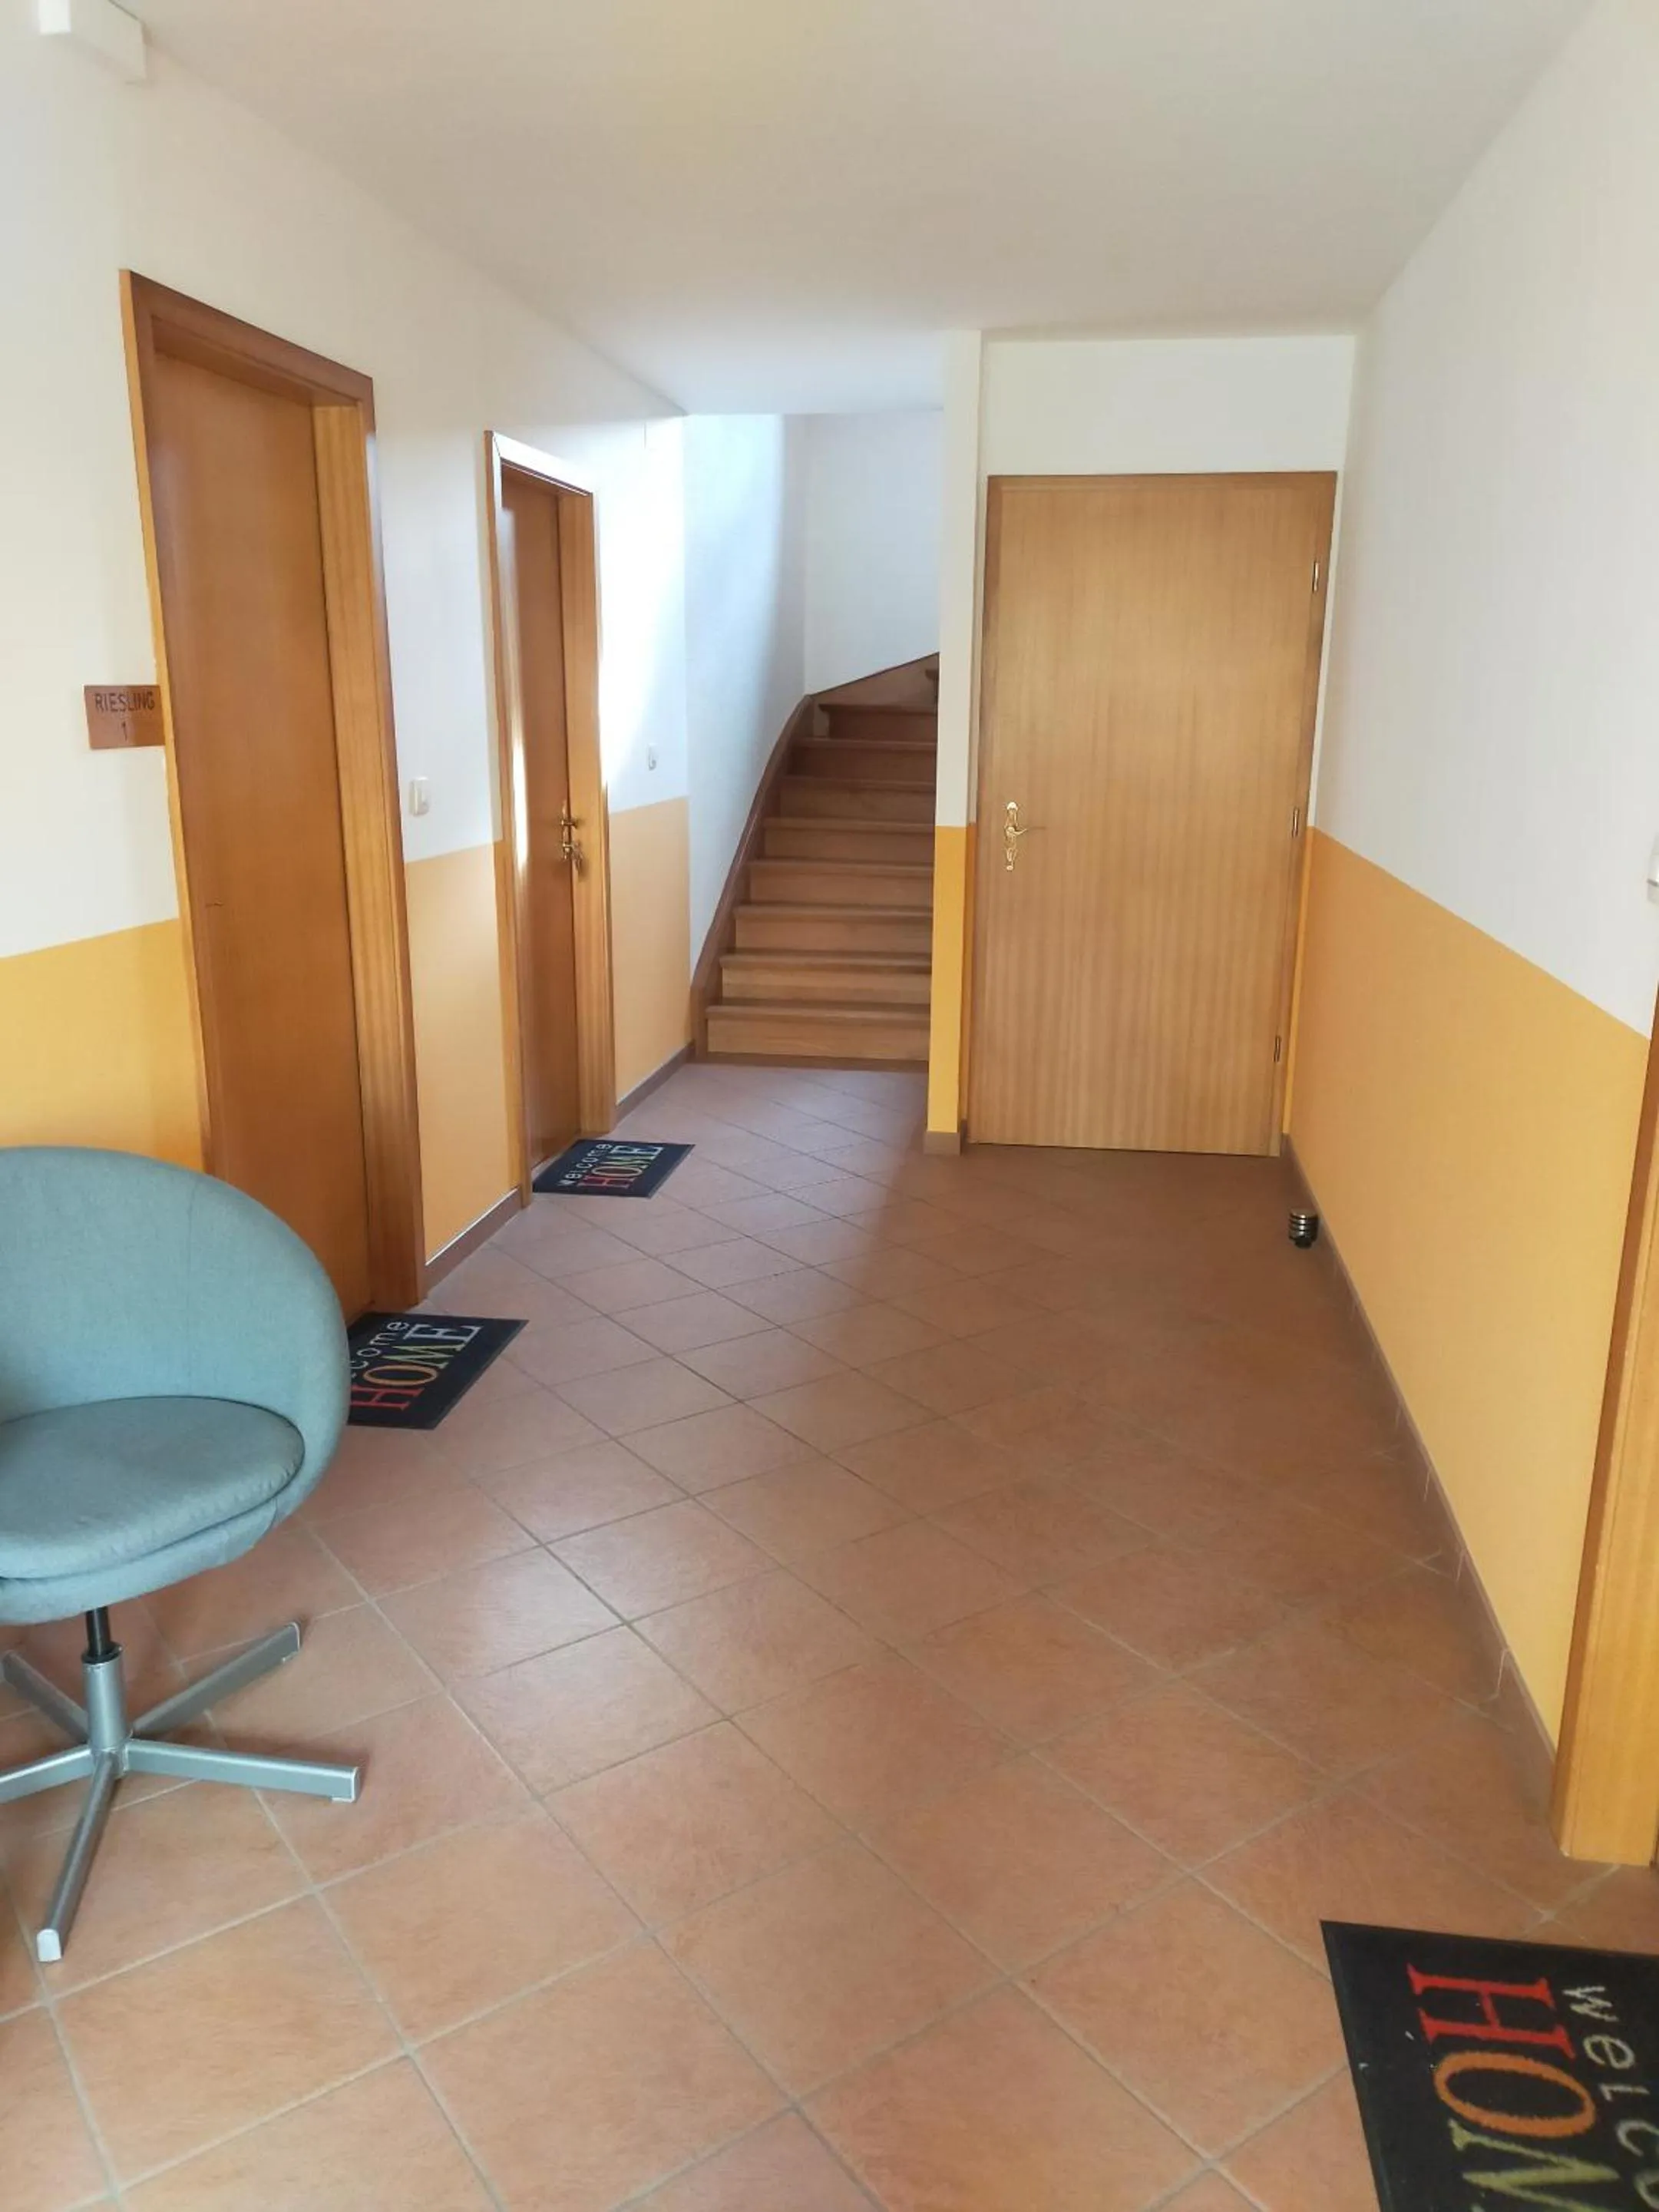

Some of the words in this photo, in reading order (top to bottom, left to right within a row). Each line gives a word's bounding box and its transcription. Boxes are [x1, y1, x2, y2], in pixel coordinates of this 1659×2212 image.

[94, 691, 155, 713] RIESLING
[121, 721, 127, 741] 1
[577, 1145, 663, 1189] HOME
[350, 1321, 408, 1379] come
[350, 1323, 483, 1411] HOME
